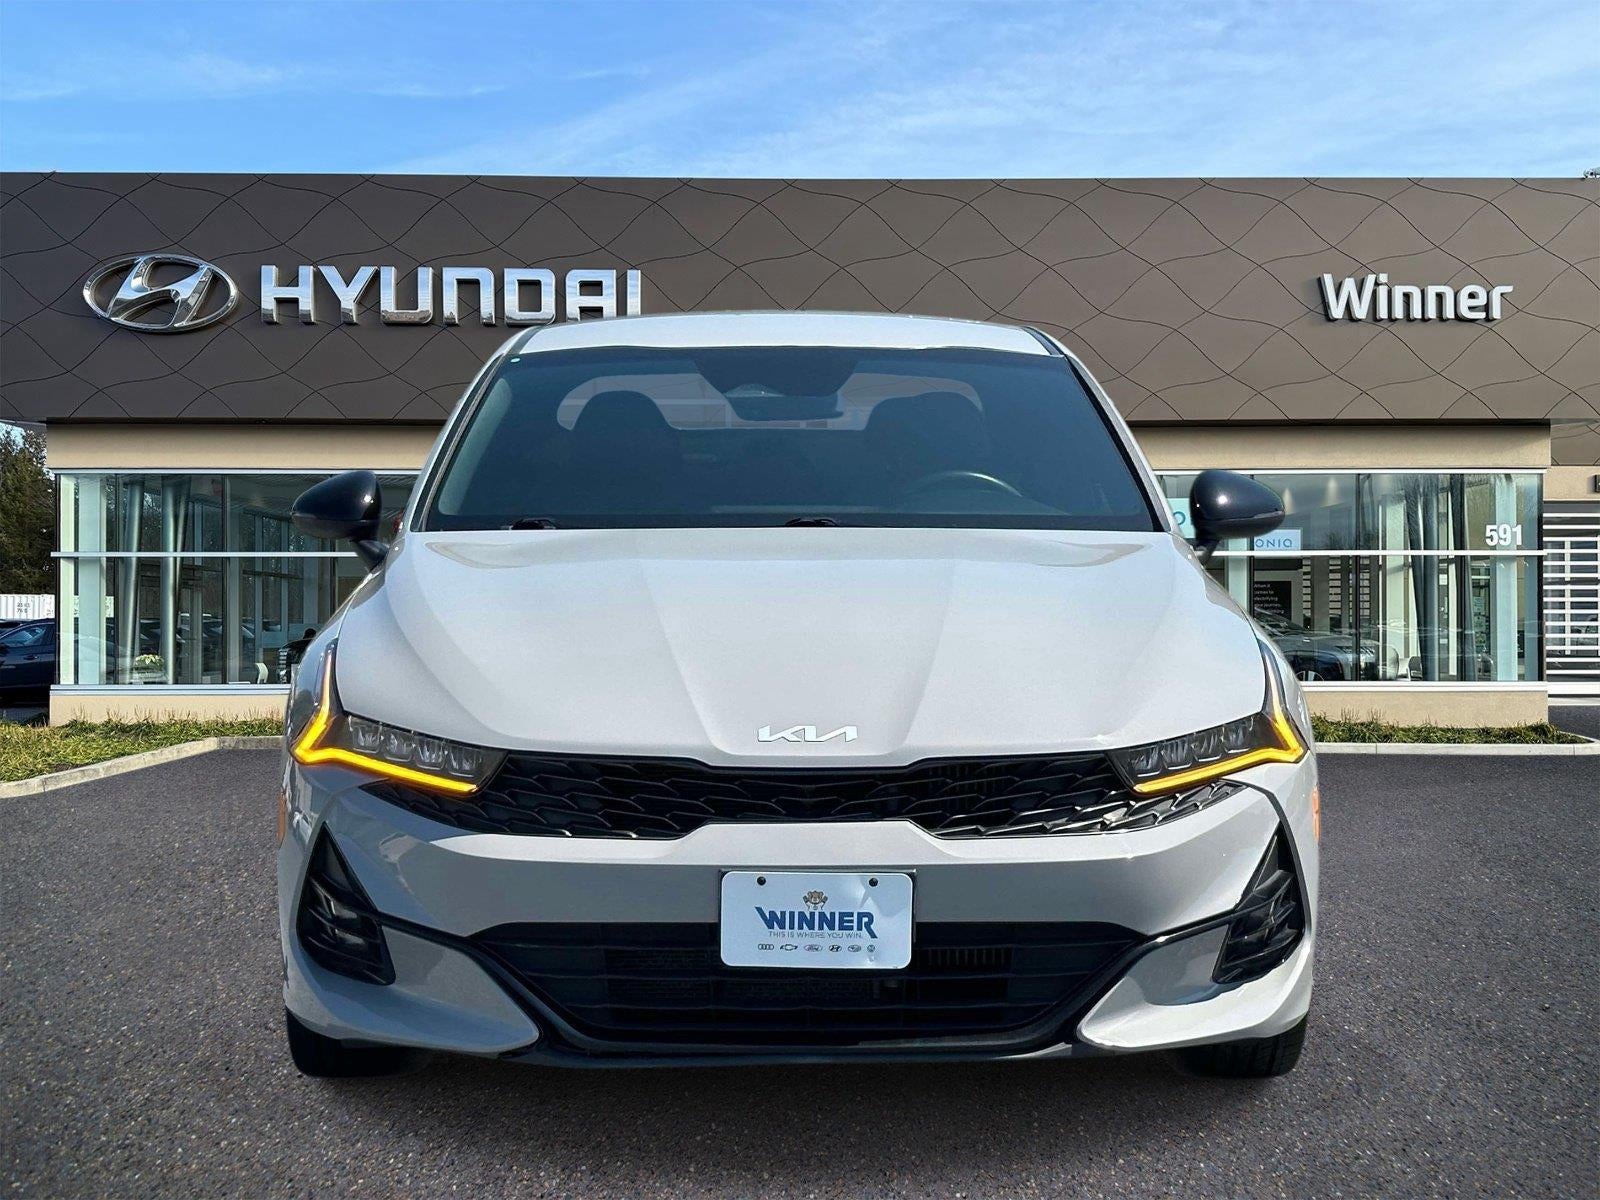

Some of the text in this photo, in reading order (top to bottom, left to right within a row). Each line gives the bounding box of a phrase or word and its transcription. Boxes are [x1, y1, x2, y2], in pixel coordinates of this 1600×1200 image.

[260, 265, 641, 324] HYUNDAI
[1320, 273, 1513, 320] Winner
[1485, 524, 1522, 546] 591
[755, 906, 878, 939] WINNER
[768, 930, 785, 938] THIS
[827, 931, 844, 939] YOU
